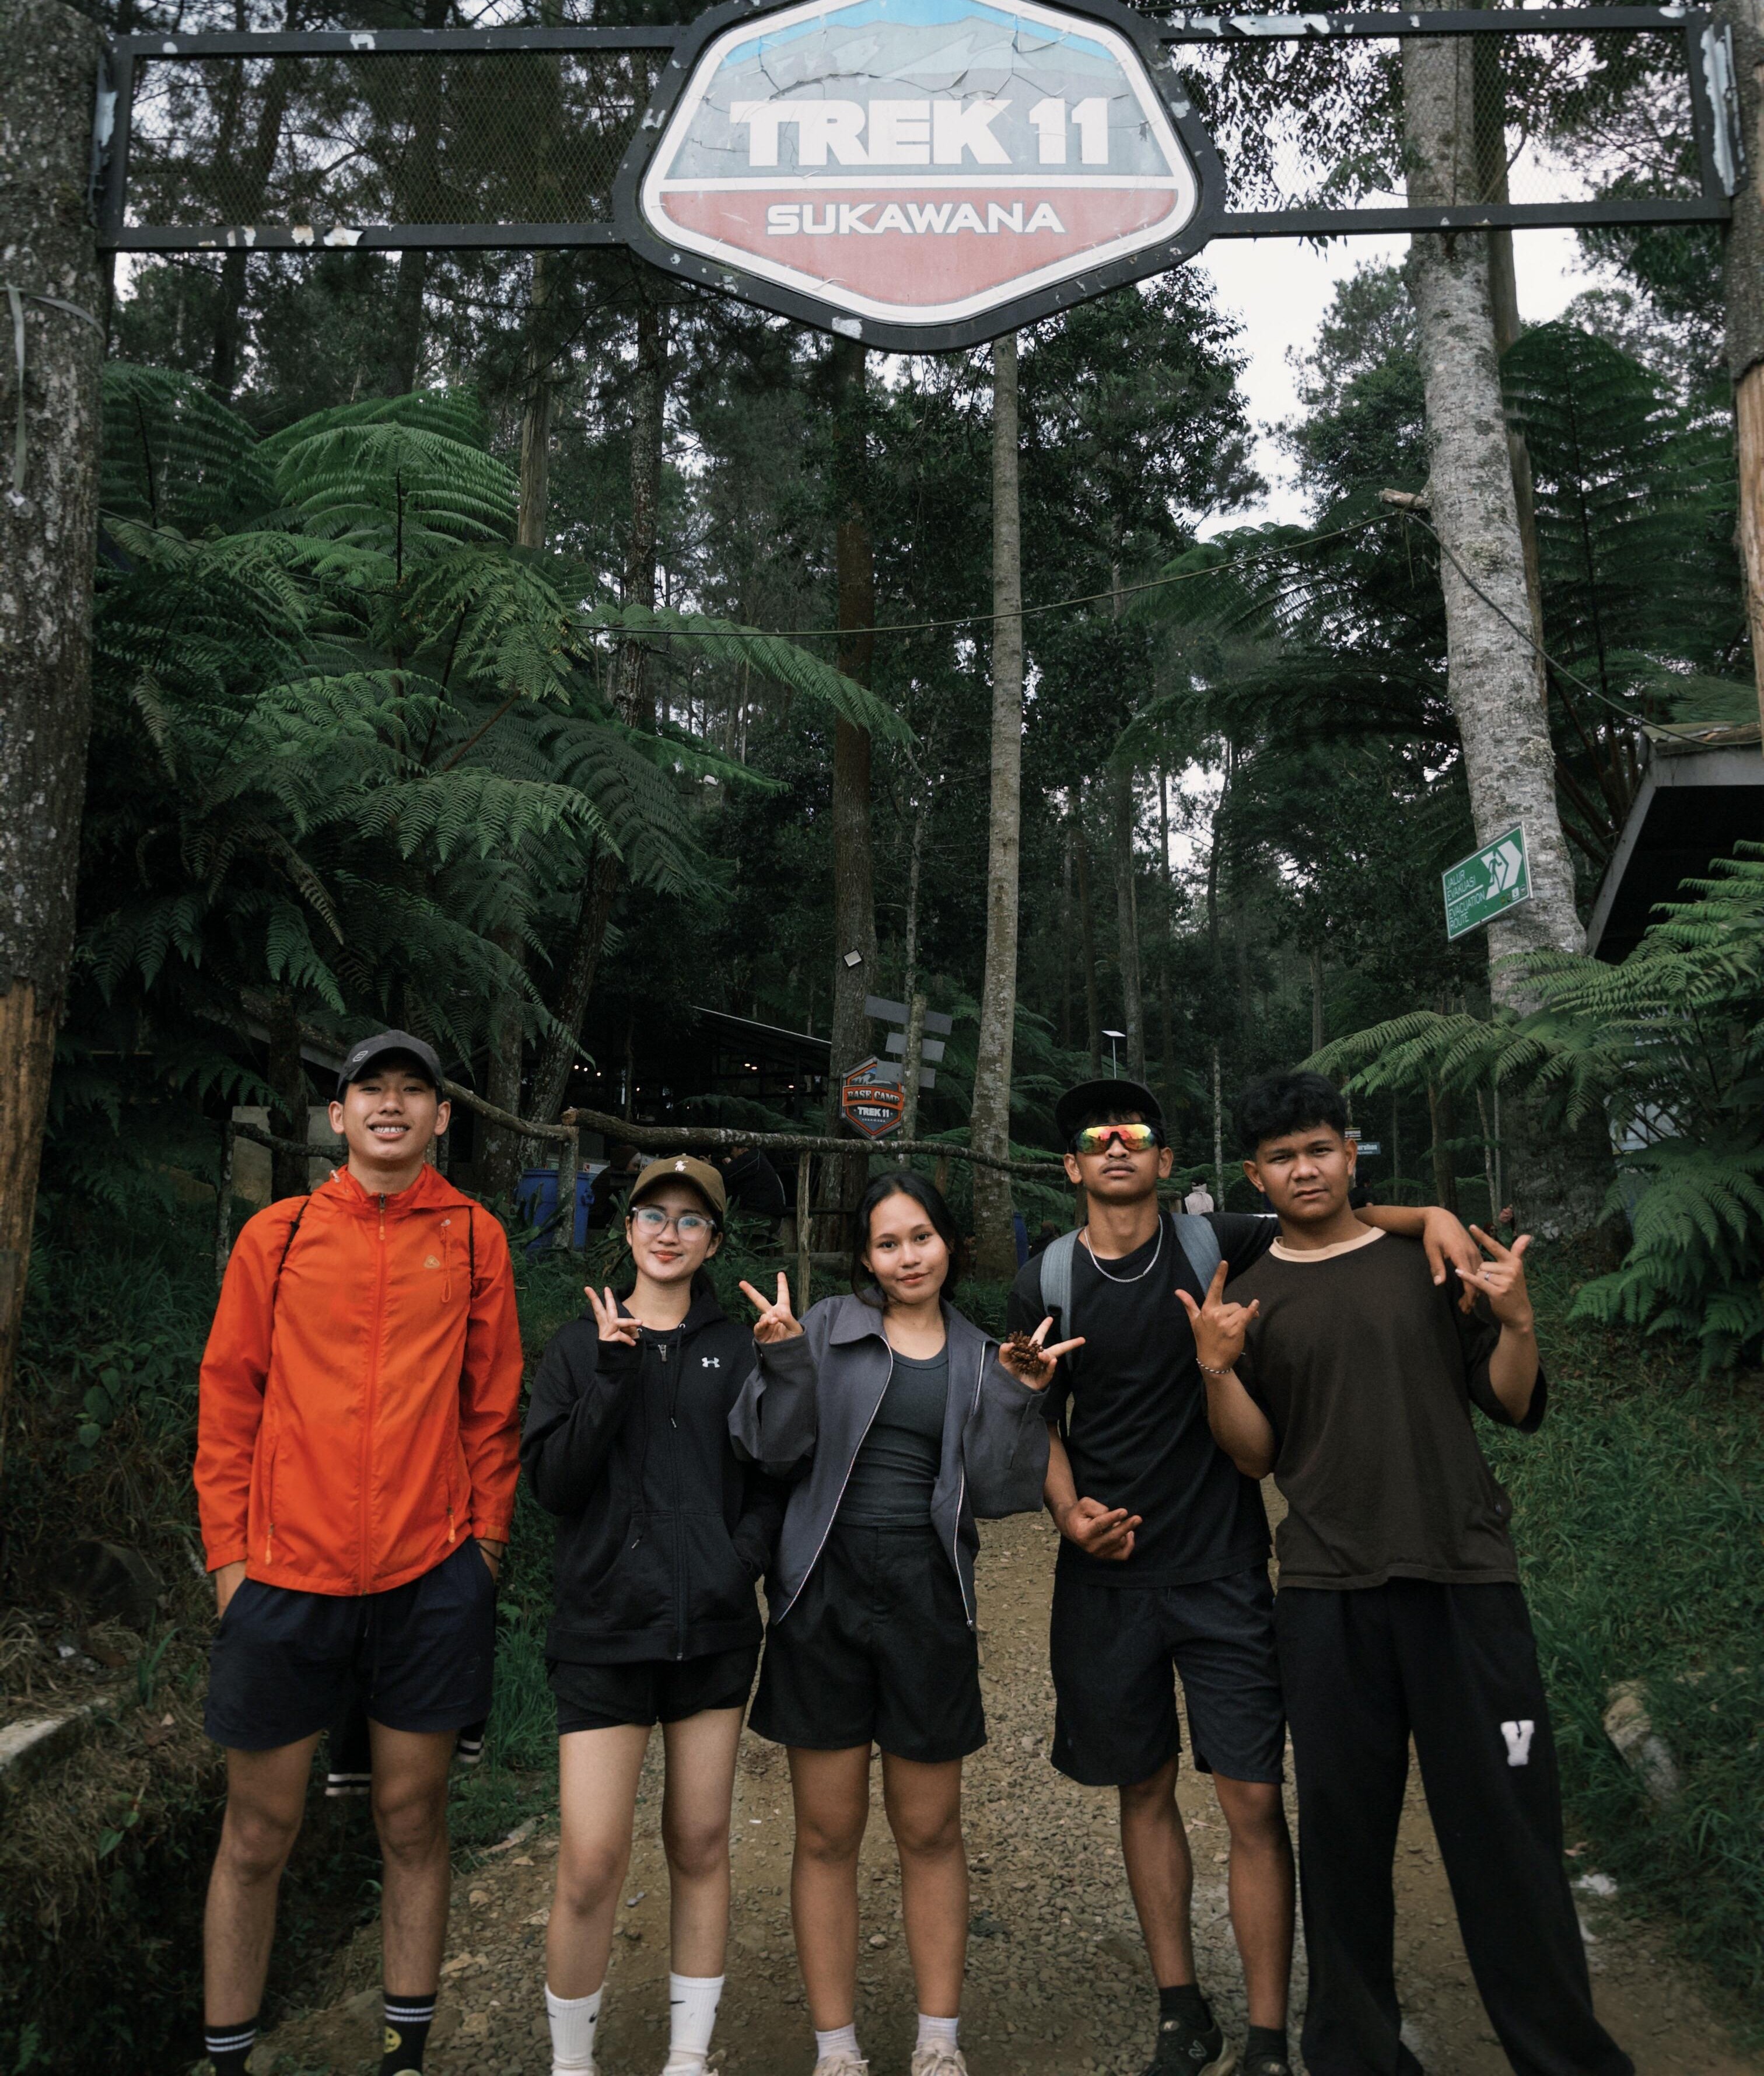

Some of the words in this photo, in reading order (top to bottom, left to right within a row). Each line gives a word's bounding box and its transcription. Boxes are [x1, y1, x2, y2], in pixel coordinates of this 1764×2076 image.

[730, 98, 1013, 167] TREK
[1029, 97, 1109, 165] 11
[766, 202, 1065, 235] SUKAWANA
[1447, 869, 1465, 890] JALUR
[1447, 875, 1476, 901] EVAKUASI
[1448, 890, 1485, 920] EVACUATION
[1450, 911, 1469, 931] ROUTE
[847, 1090, 872, 1101] BASE
[874, 1091, 900, 1103] CAMP
[857, 1106, 881, 1117] TREK
[882, 1109, 890, 1117] 11
